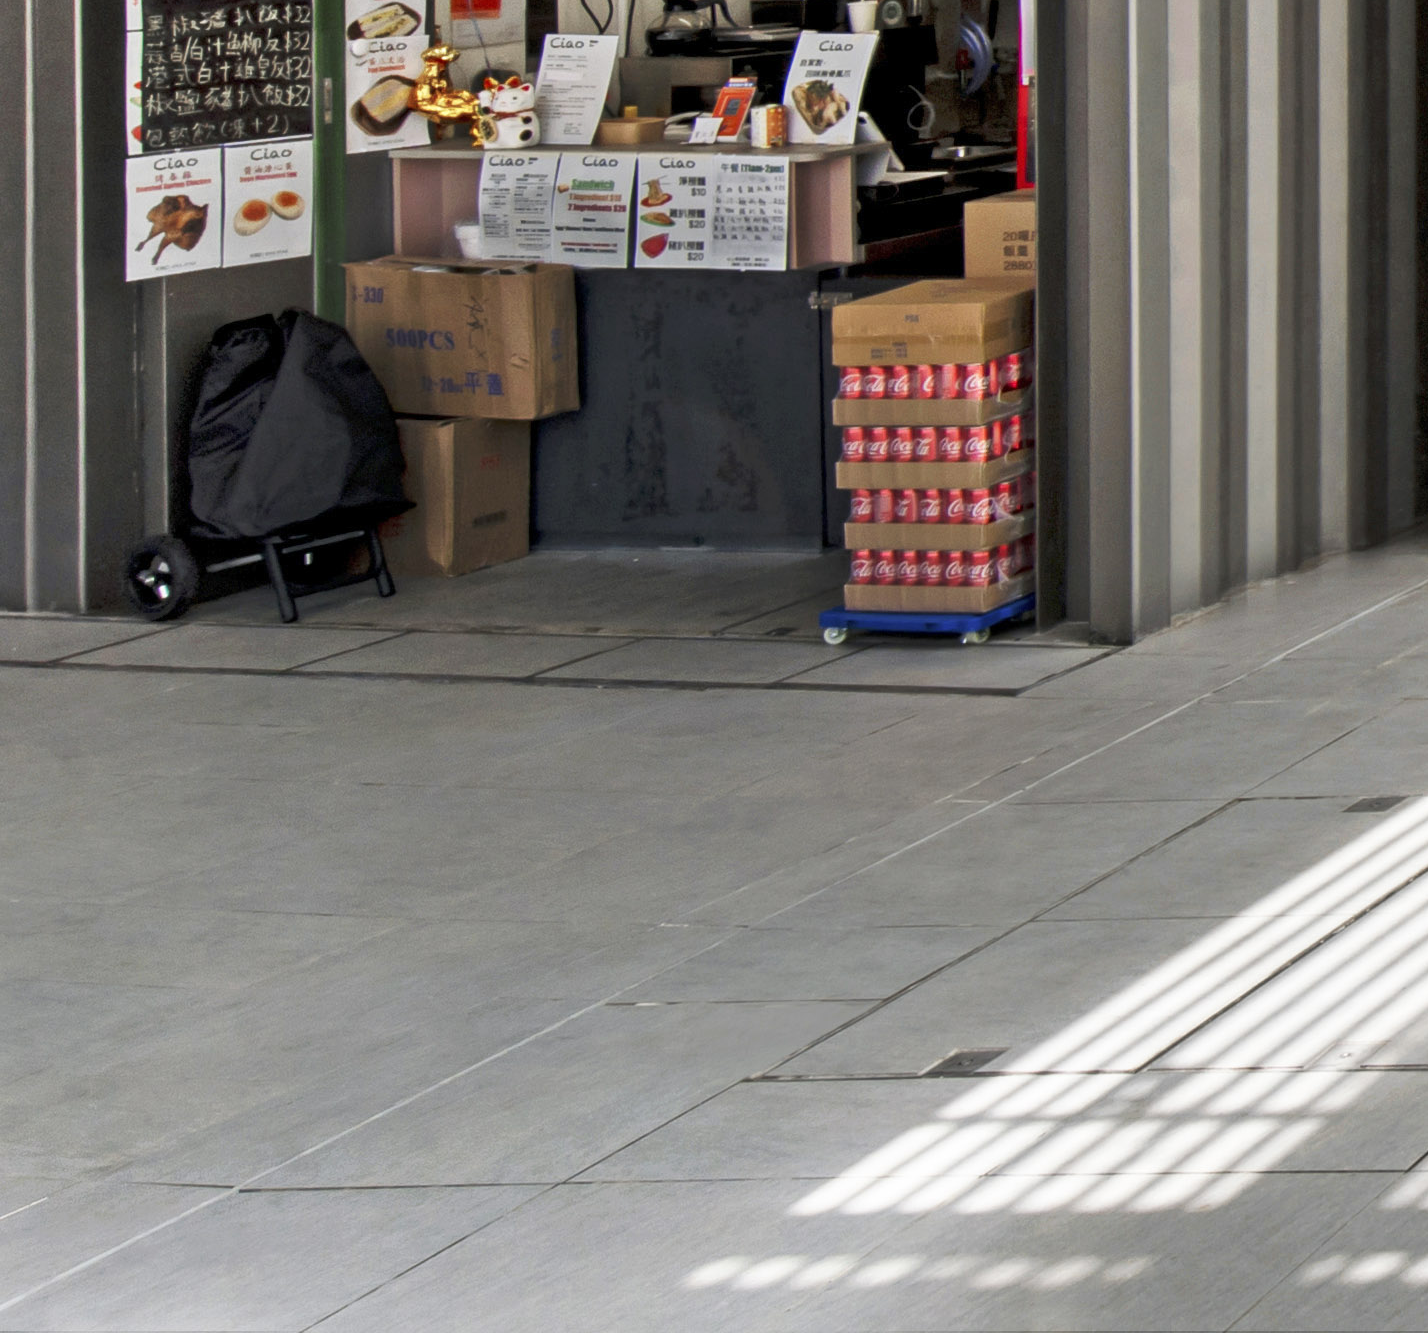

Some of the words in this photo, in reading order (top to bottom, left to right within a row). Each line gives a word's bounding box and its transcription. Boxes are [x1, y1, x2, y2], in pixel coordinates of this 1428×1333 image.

[550, 37, 584, 49] Ciao
[818, 41, 854, 52] Ciao
[251, 148, 292, 161] Ciao
[154, 158, 198, 170] Ciao
[489, 155, 525, 167] Ciao
[582, 156, 619, 167] Ciao
[659, 157, 696, 169] Ciao
[691, 188, 706, 196] $10
[689, 220, 706, 229] $20
[688, 252, 704, 261] $20
[386, 329, 456, 352] 500PCS
